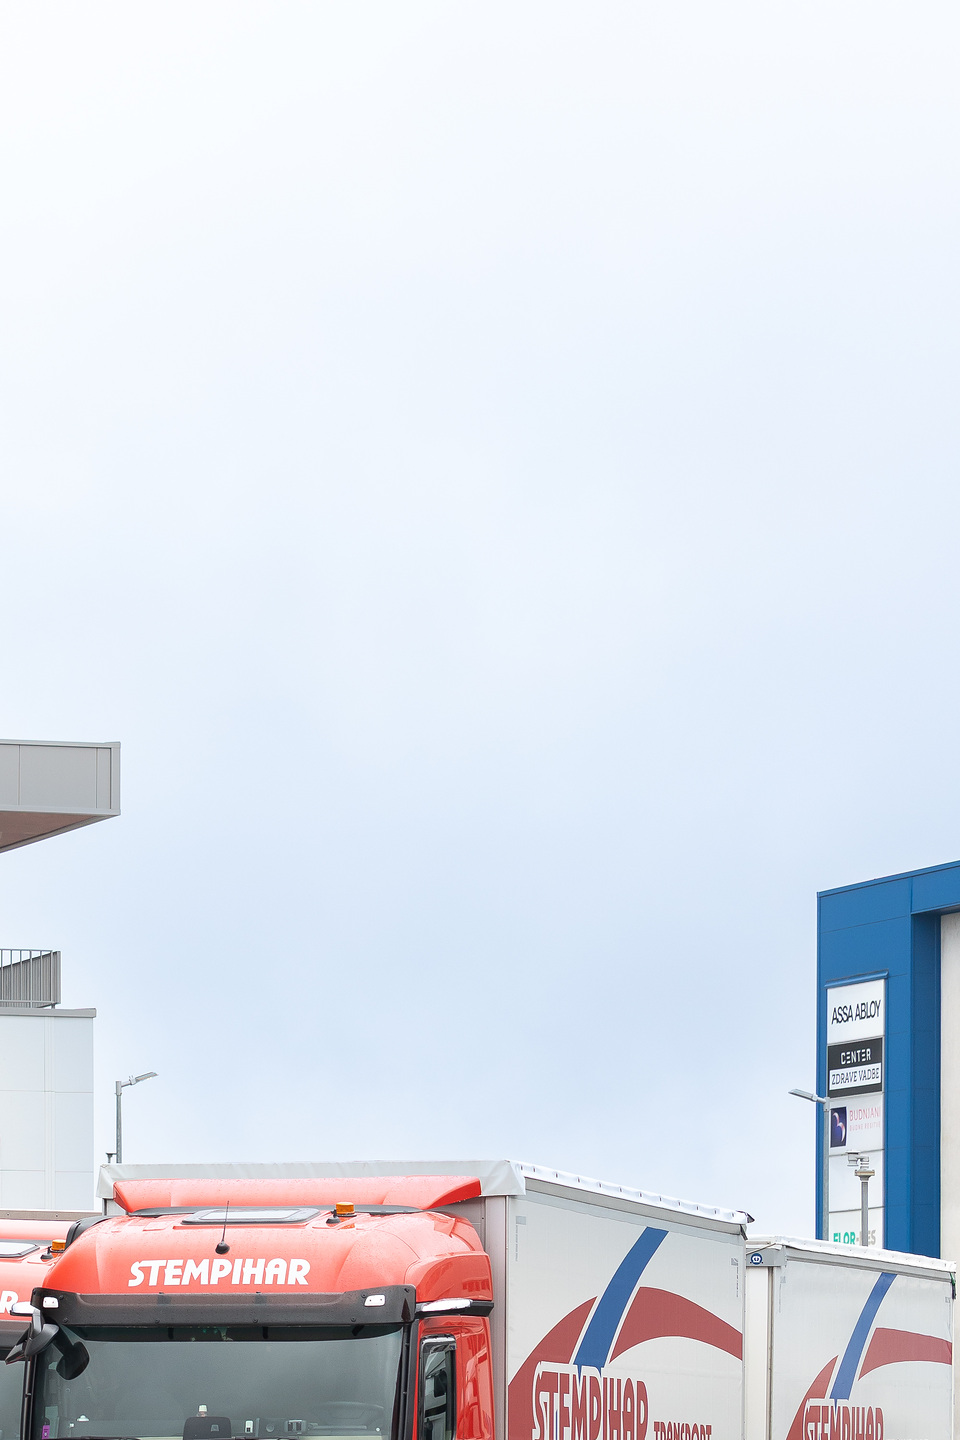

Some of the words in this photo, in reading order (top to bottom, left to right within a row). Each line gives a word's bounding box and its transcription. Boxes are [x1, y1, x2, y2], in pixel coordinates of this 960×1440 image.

[831, 1004, 854, 1025] ASSA
[854, 999, 882, 1021] ABLOY
[840, 1048, 872, 1065] CENTER
[831, 1070, 858, 1085] ZDRAVE
[859, 1067, 880, 1081] VADBE
[128, 1258, 311, 1287] STEMPIHAR
